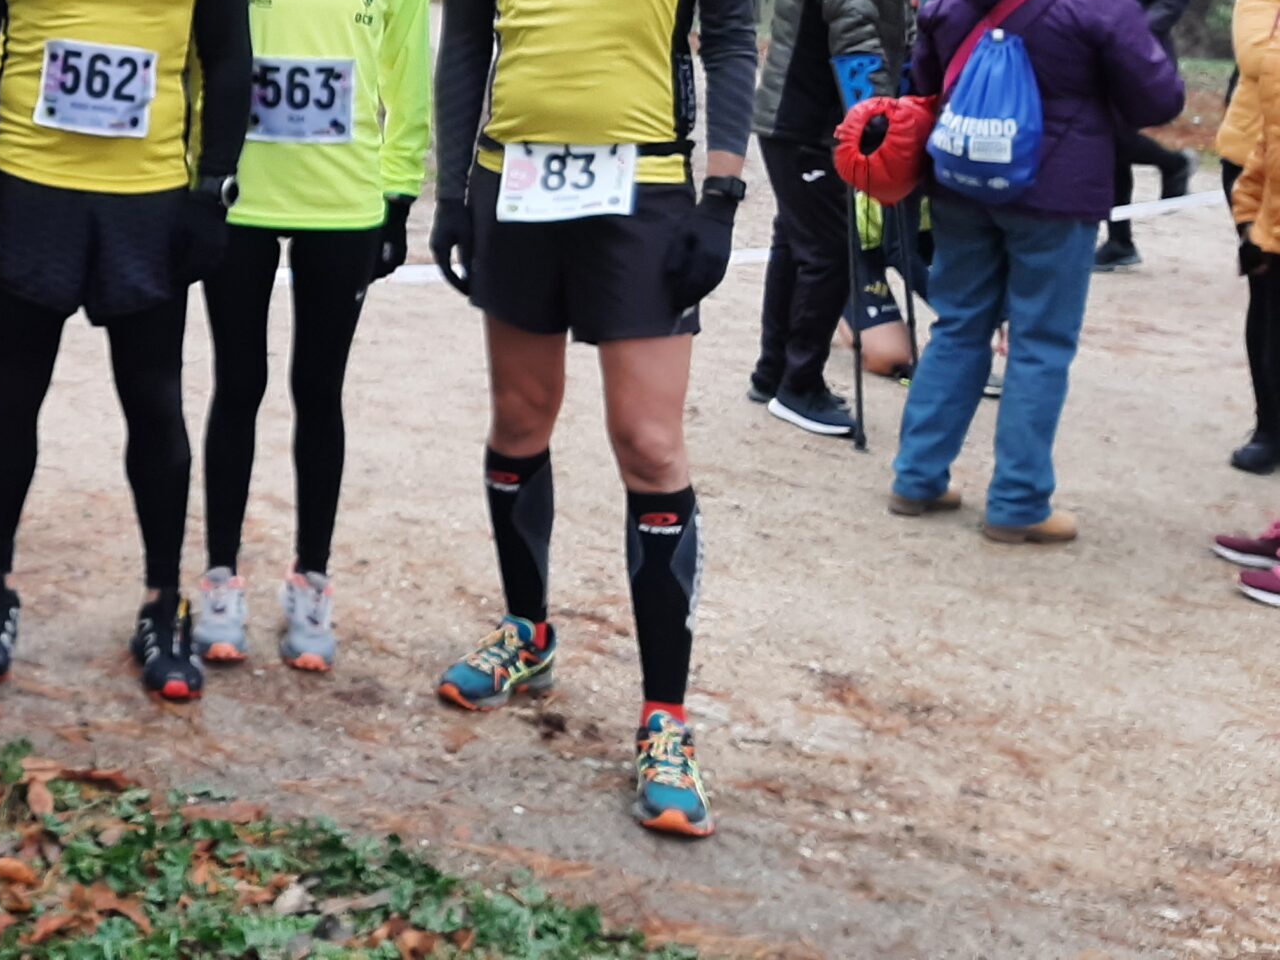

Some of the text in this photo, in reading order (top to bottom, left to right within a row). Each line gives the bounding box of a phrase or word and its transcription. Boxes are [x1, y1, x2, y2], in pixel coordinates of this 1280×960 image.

[60, 49, 138, 103] 562
[257, 65, 336, 111] 563
[540, 152, 596, 191] 83
